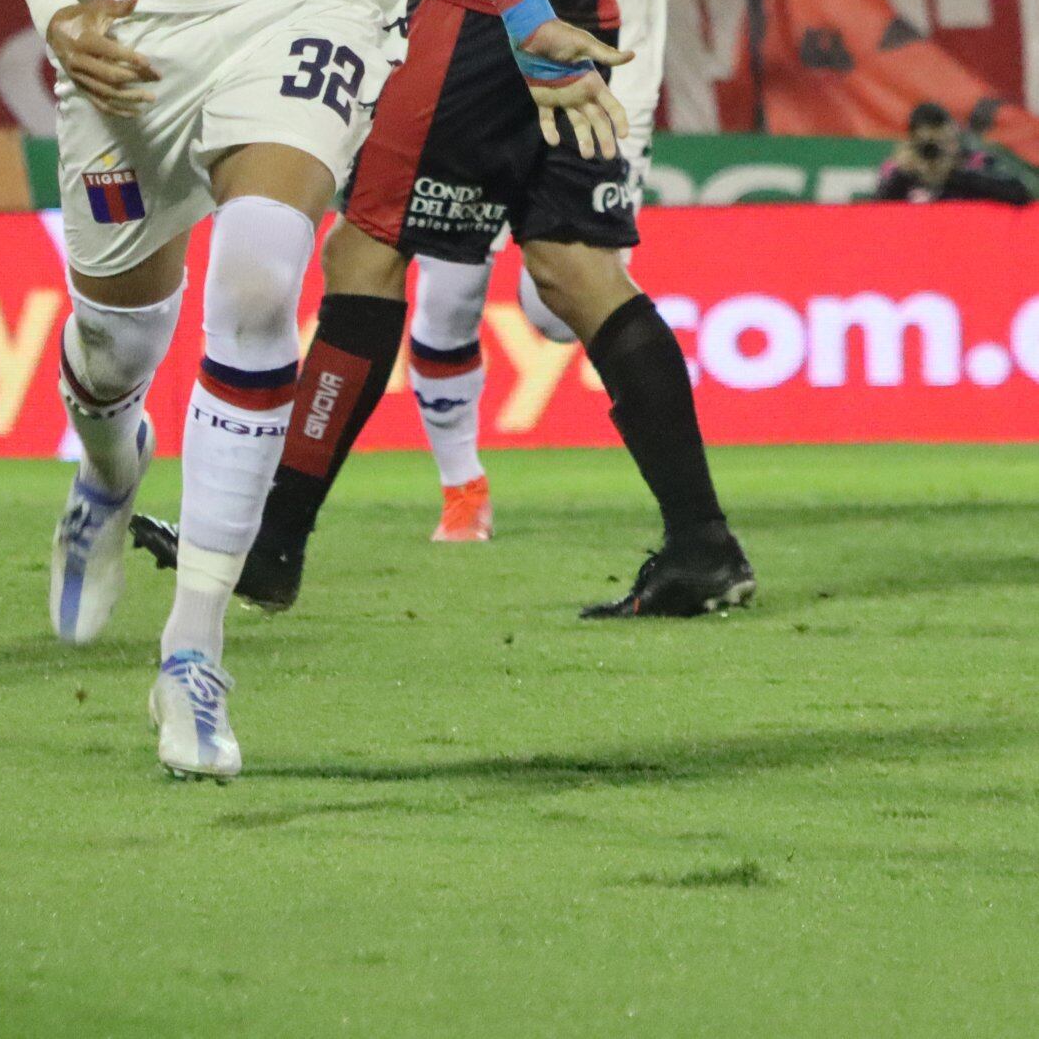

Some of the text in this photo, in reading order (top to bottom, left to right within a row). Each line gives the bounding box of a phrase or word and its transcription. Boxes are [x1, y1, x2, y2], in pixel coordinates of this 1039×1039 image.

[279, 37, 365, 127] 32
[85, 170, 134, 186] TIGRE
[192, 404, 285, 437] TIGR
[304, 371, 344, 440] GIVOVA
